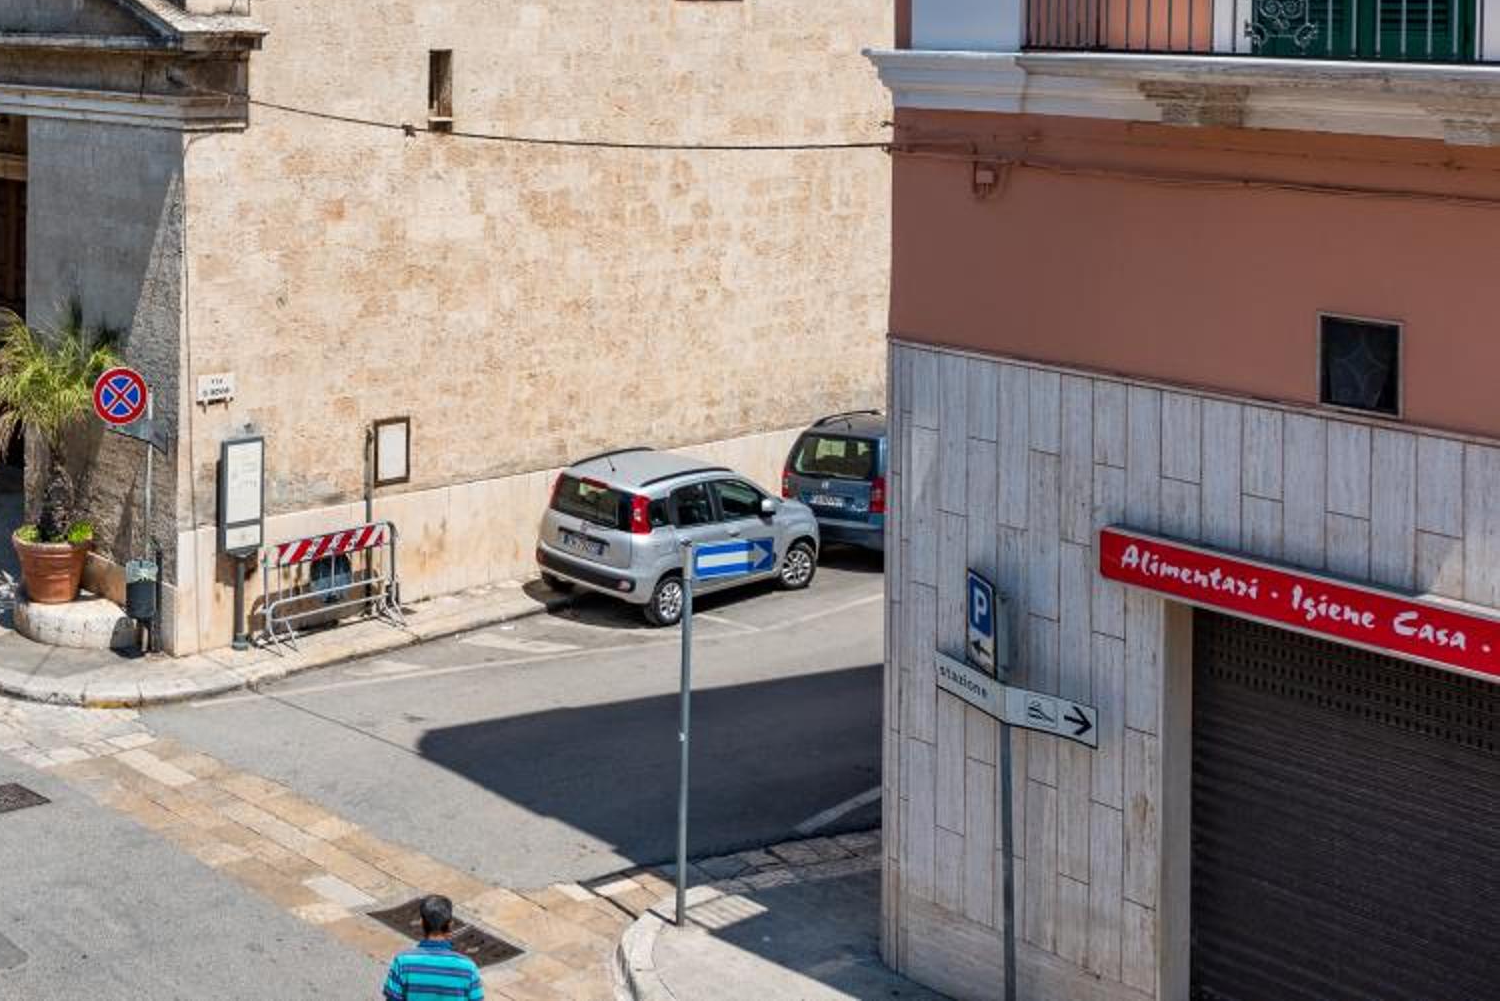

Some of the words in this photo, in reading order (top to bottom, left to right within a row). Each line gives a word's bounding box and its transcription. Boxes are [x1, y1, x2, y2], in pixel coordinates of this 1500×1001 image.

[973, 586, 988, 624] P
[1121, 544, 1259, 599] Alimentari
[1291, 585, 1375, 629] Igiene
[1392, 611, 1466, 651] Casa
[939, 665, 988, 699] stazione
